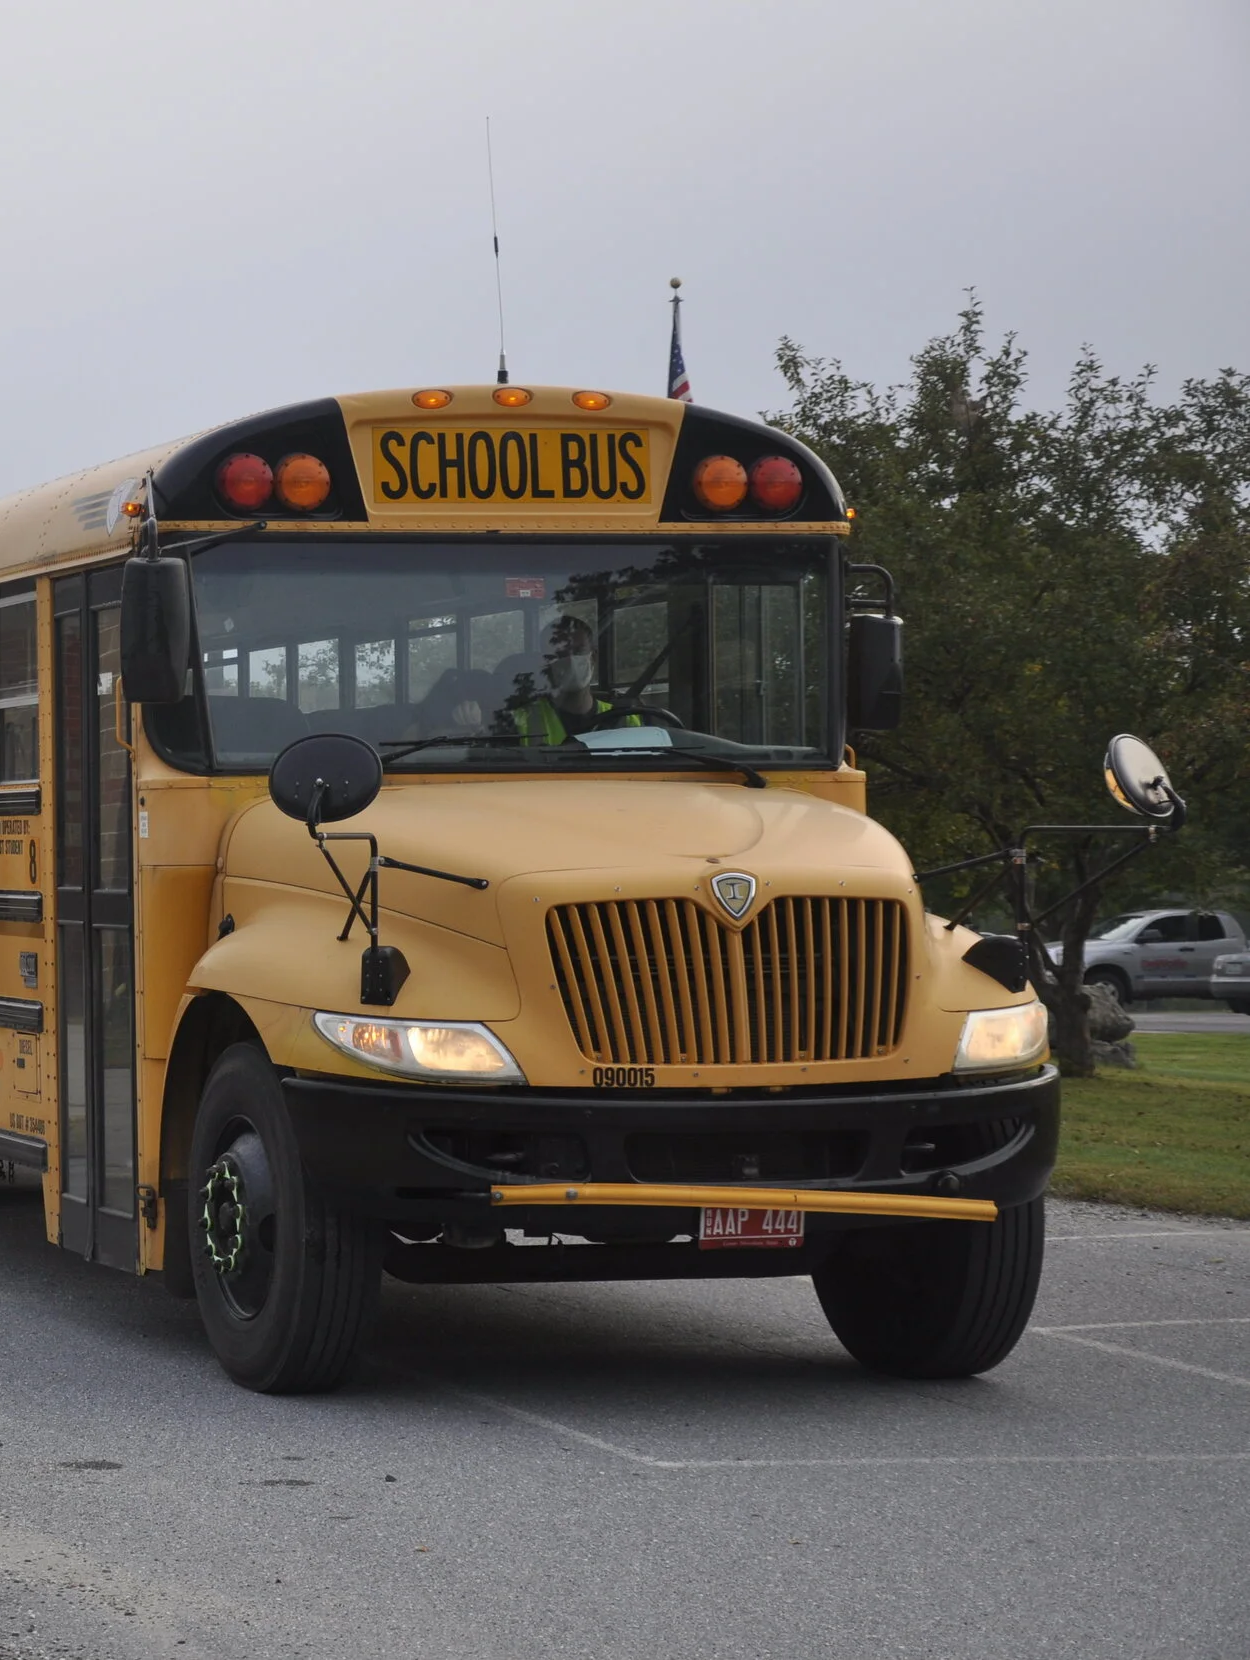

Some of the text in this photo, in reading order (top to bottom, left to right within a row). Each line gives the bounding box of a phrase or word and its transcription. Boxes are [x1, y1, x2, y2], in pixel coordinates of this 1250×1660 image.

[379, 430, 646, 500] SCHOOL BUS
[29, 839, 36, 884] 8
[593, 1067, 655, 1087] 090015
[713, 1208, 798, 1235] AAP 444
